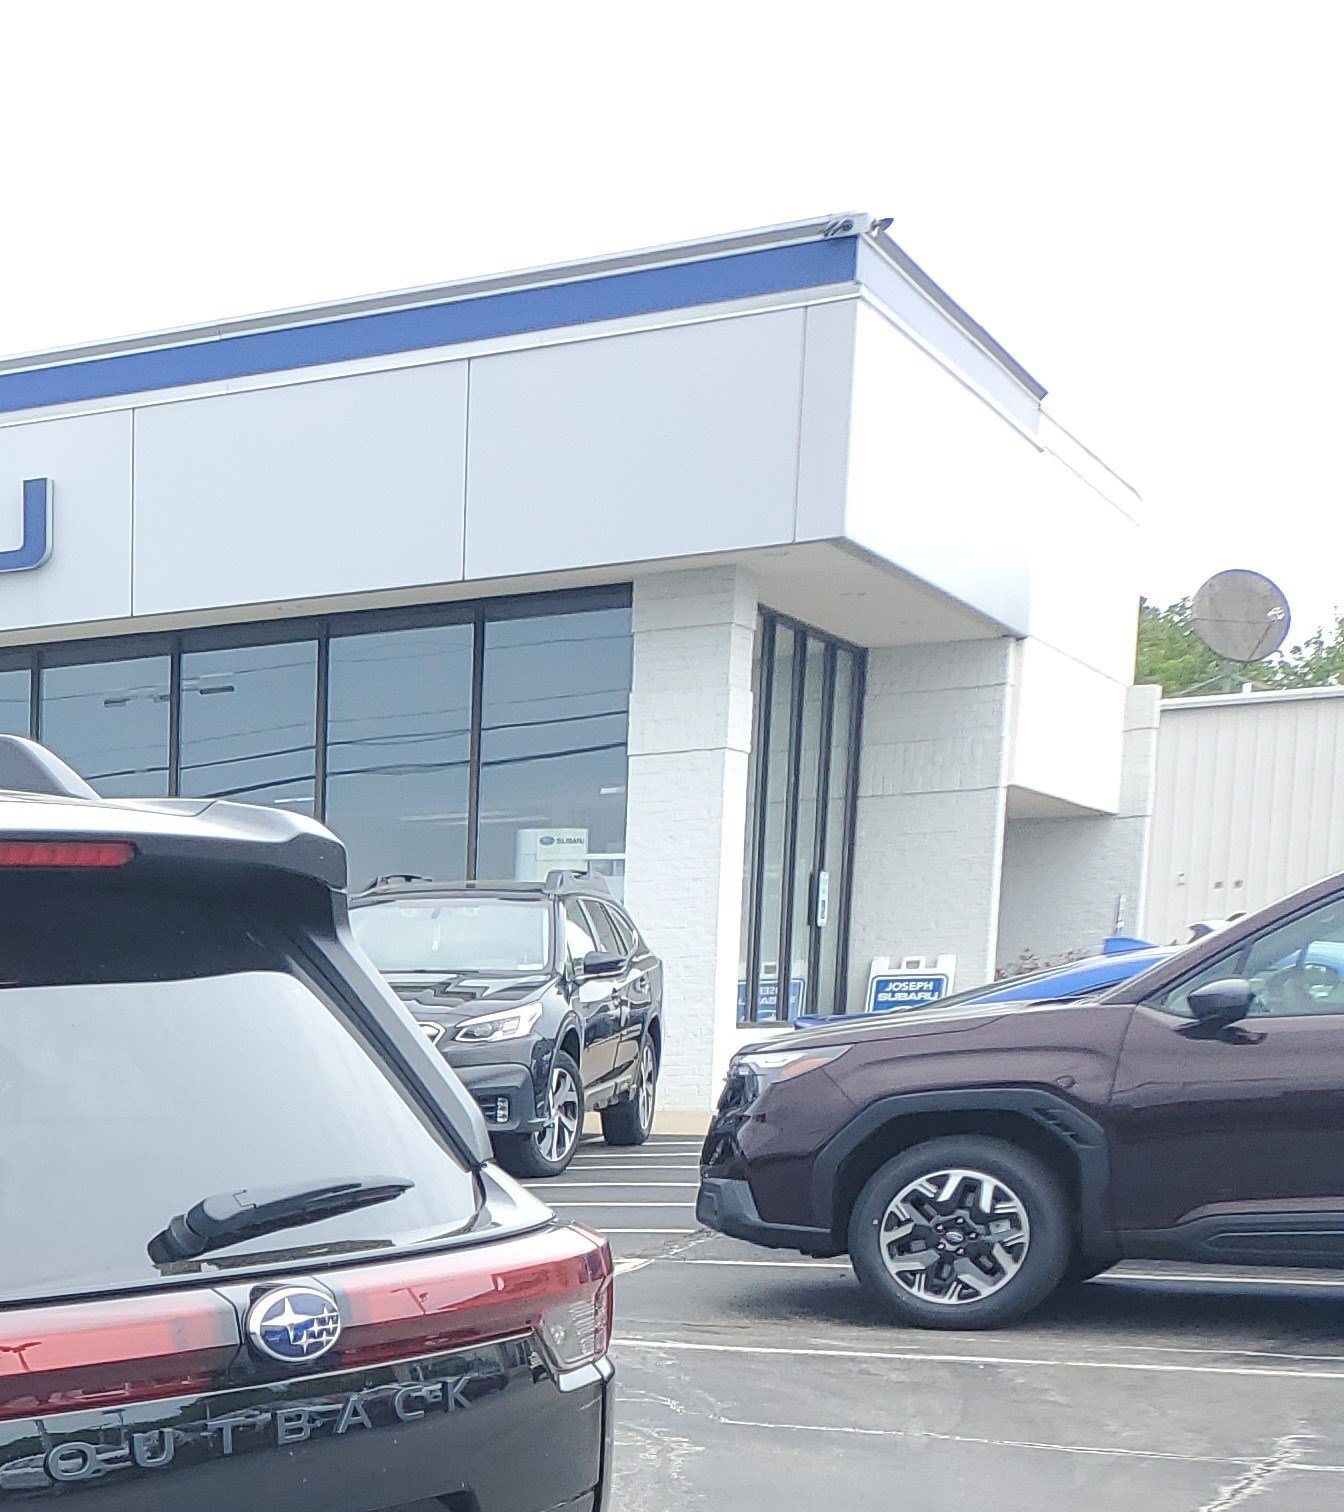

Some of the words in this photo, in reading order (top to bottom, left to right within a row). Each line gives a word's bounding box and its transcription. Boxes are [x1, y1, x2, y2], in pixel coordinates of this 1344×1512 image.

[884, 981, 935, 992] JOSEPH
[876, 991, 940, 1002] SUBARU
[43, 1375, 472, 1482] OUTBACK
